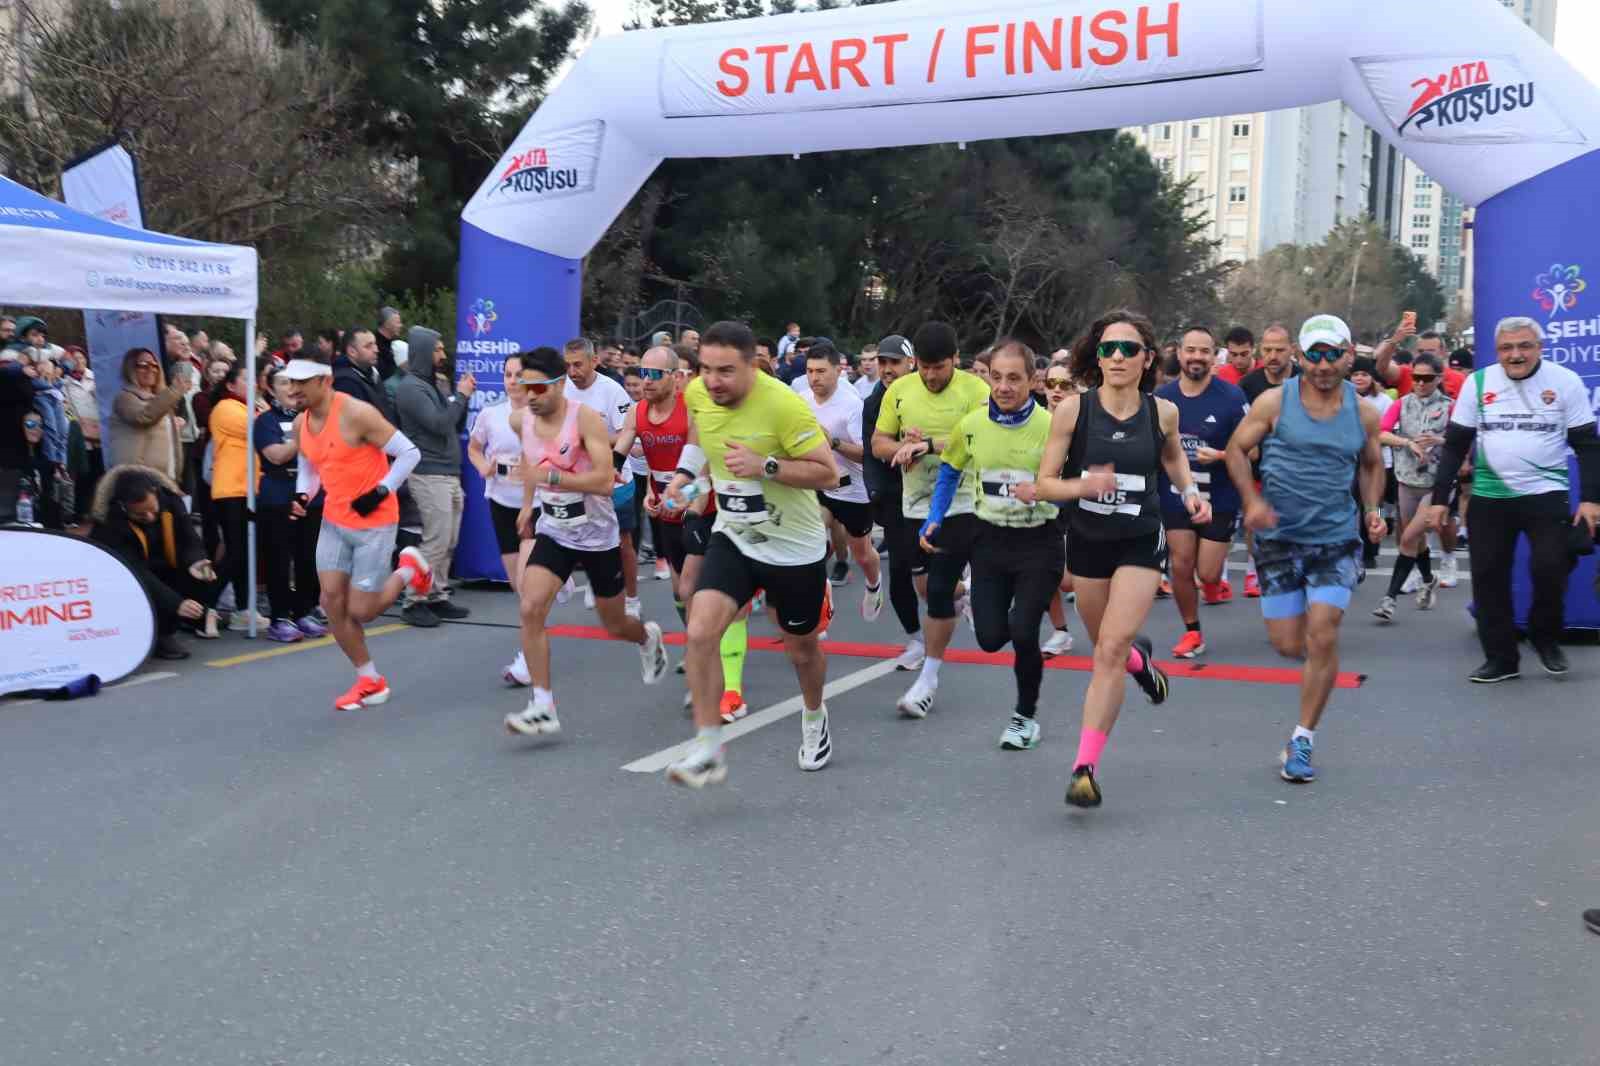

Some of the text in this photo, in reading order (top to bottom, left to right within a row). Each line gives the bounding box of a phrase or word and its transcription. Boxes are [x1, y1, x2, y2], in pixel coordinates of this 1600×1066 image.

[715, 2, 1180, 98] START / FINISH
[1447, 60, 1490, 92] ATA
[1437, 81, 1535, 127] KOŞUSU
[524, 147, 549, 167] ATA
[513, 167, 578, 194] KOŞUSU
